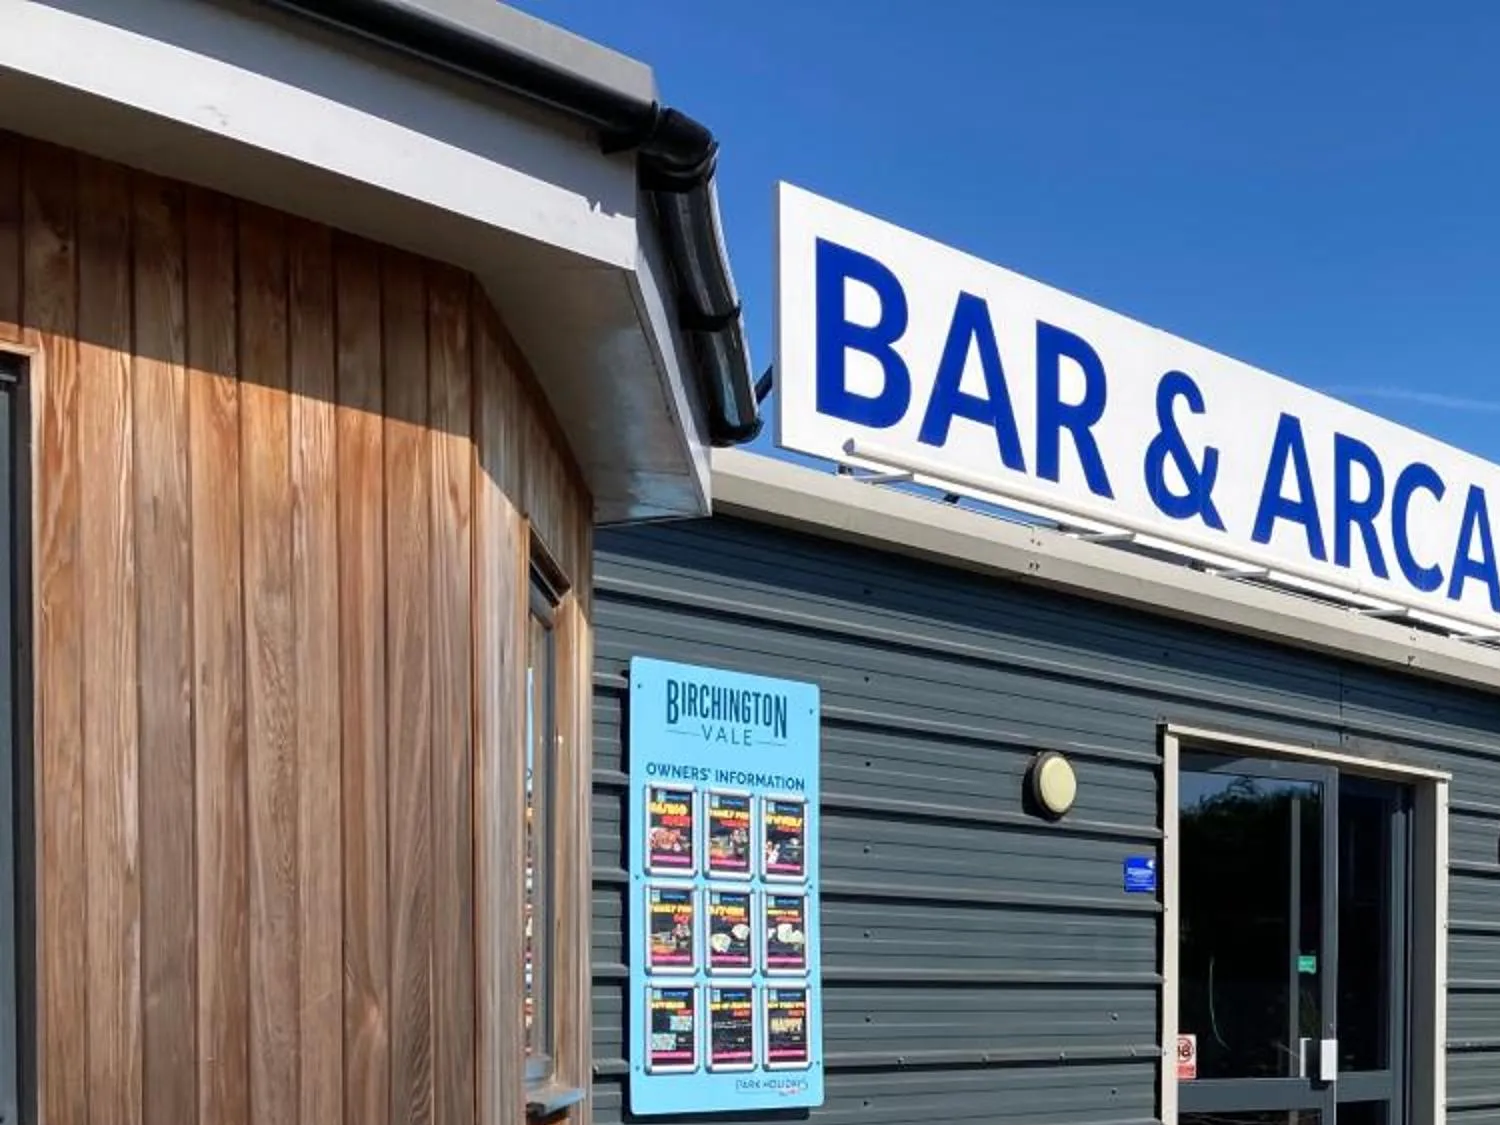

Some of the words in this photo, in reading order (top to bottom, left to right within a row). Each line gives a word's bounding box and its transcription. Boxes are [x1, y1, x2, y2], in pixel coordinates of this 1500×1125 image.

[815, 237, 1114, 500] BAR
[1144, 369, 1227, 532] &
[666, 679, 788, 739] BIRCHINGTON
[701, 724, 753, 746] VALE
[715, 769, 805, 791] INFORMATION
